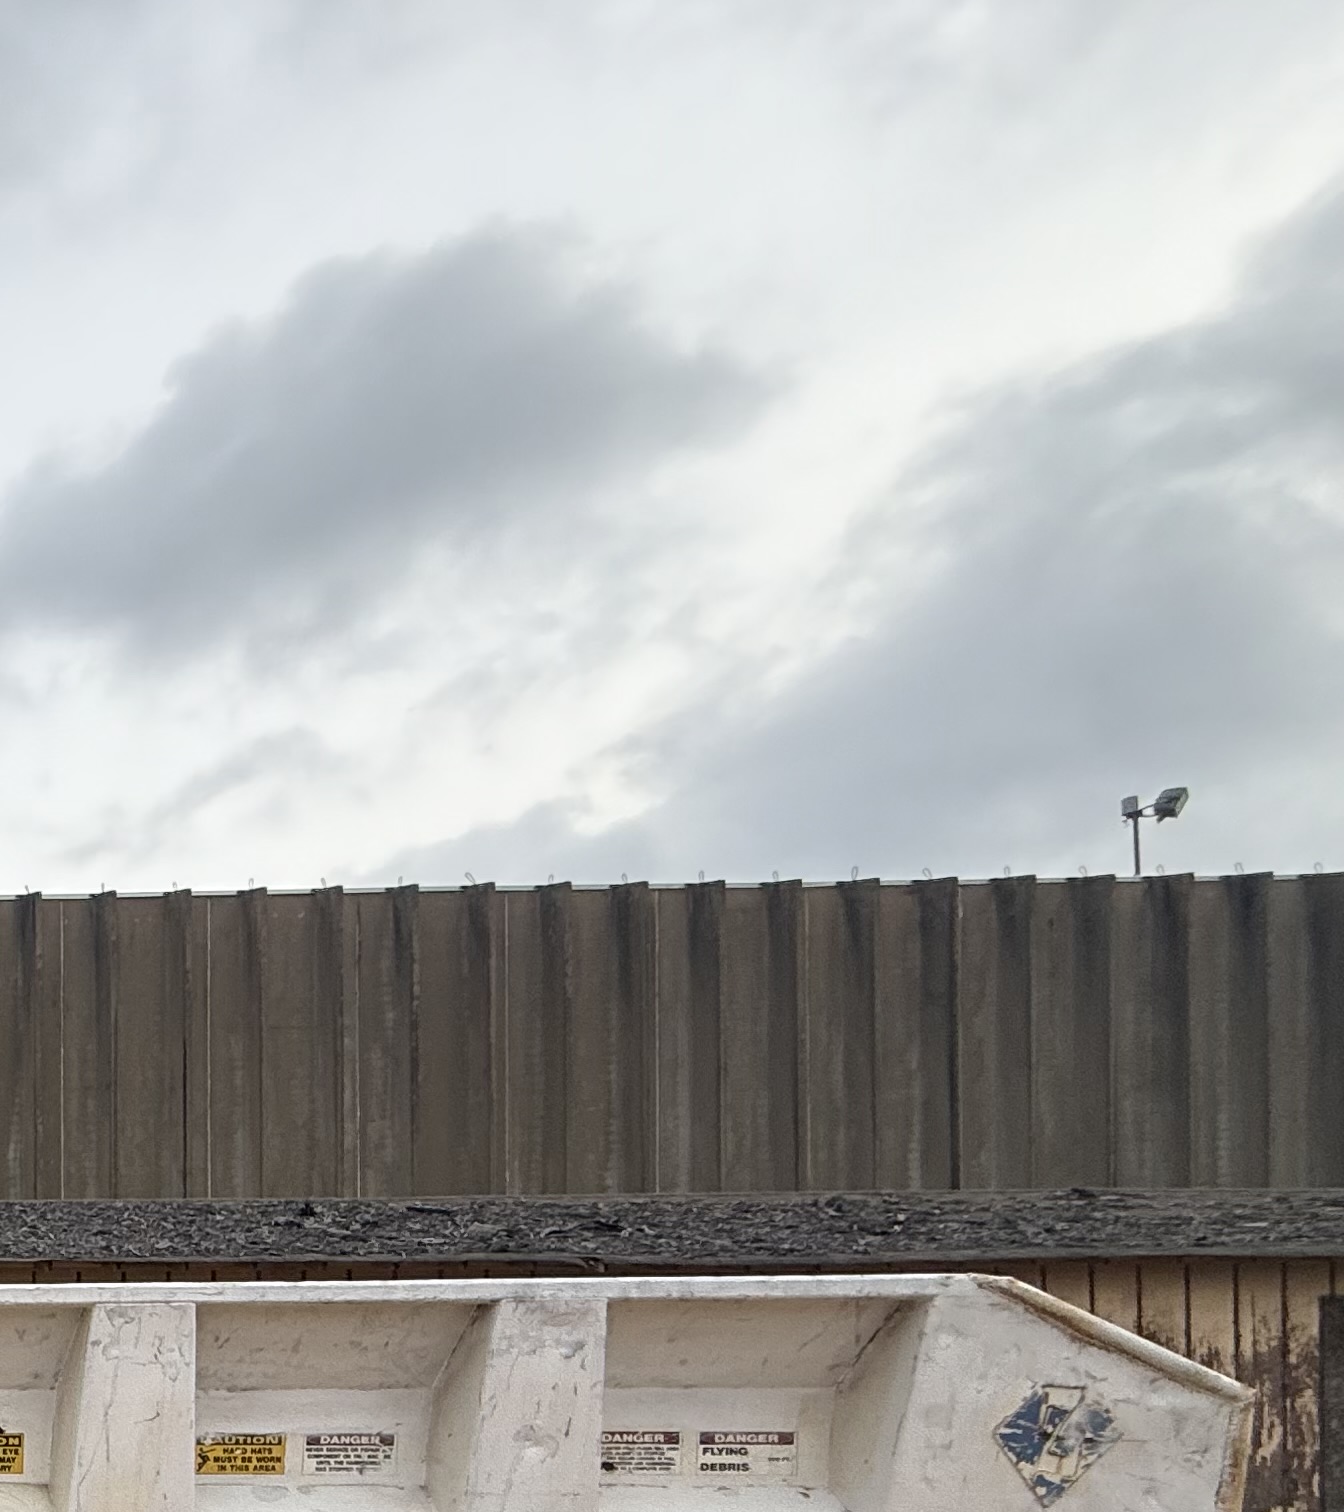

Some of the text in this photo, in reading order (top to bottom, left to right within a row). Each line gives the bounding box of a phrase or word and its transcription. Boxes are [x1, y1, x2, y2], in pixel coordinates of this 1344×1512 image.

[200, 1436, 279, 1444] AUTION
[320, 1436, 380, 1444] DANGER
[602, 1434, 664, 1442] DANGER
[714, 1434, 778, 1442] DANGER
[702, 1447, 748, 1456] FLYING
[700, 1463, 749, 1471] DEBRIS
